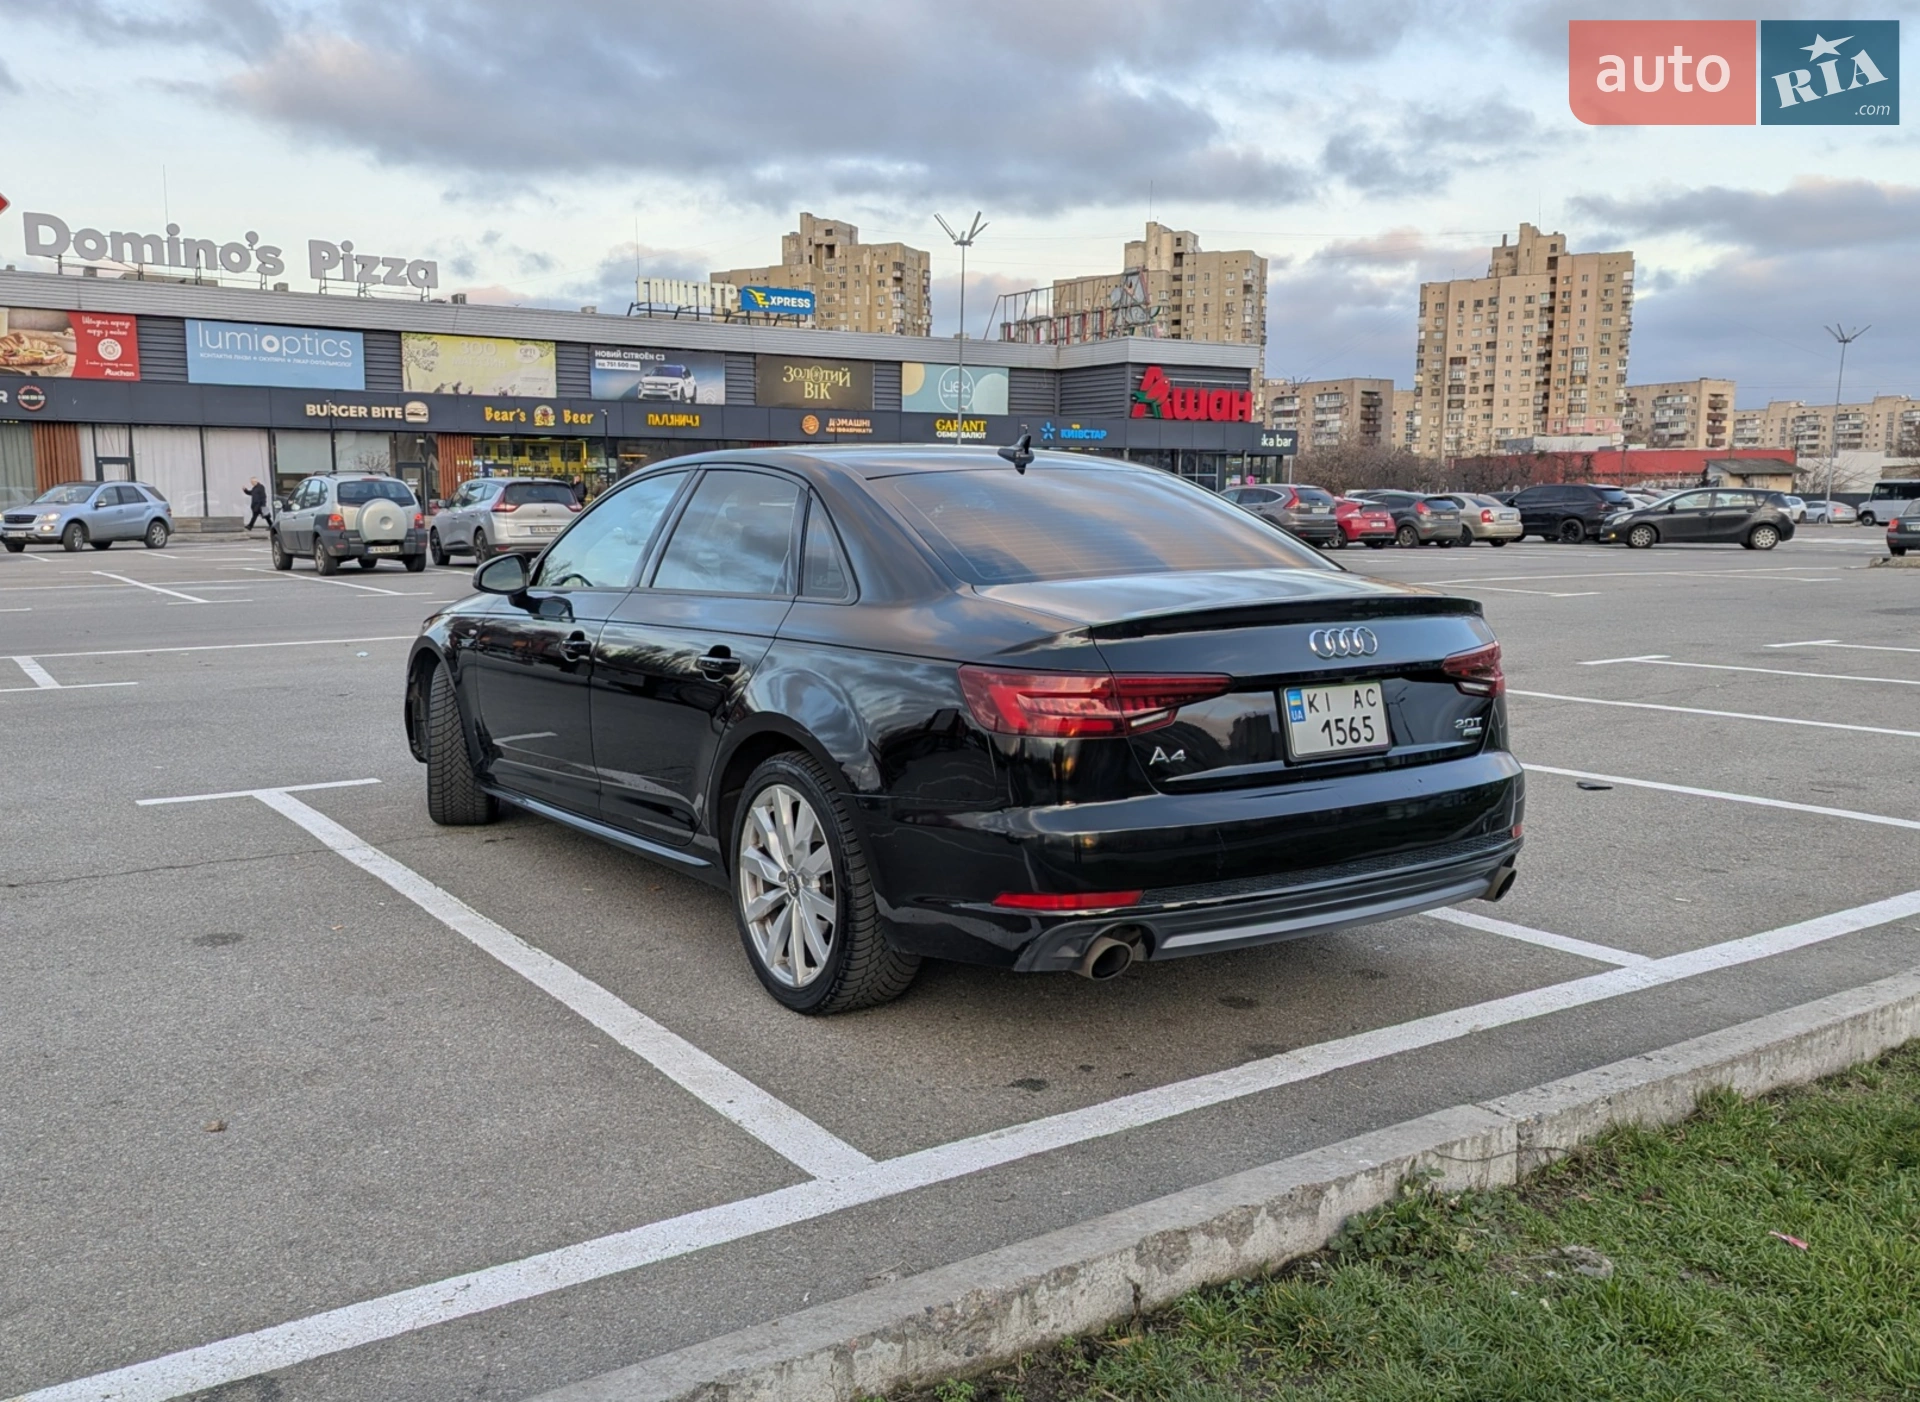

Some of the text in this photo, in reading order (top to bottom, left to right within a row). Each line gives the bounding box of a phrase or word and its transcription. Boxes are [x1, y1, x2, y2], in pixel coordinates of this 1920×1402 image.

[23, 211, 439, 289] Domino's Pizza
[198, 322, 353, 358] lumioptics
[594, 350, 666, 361] НОВИЙ CITROËN C3
[104, 367, 135, 377] Auchan
[305, 403, 403, 419] BURGER BITE
[484, 406, 594, 424] Bear's Beer
[1276, 433, 1293, 447] bar
[1307, 688, 1377, 714] KI AC
[1290, 709, 1304, 721] UA
[1321, 715, 1375, 747] 1565
[1148, 745, 1187, 765] A4
